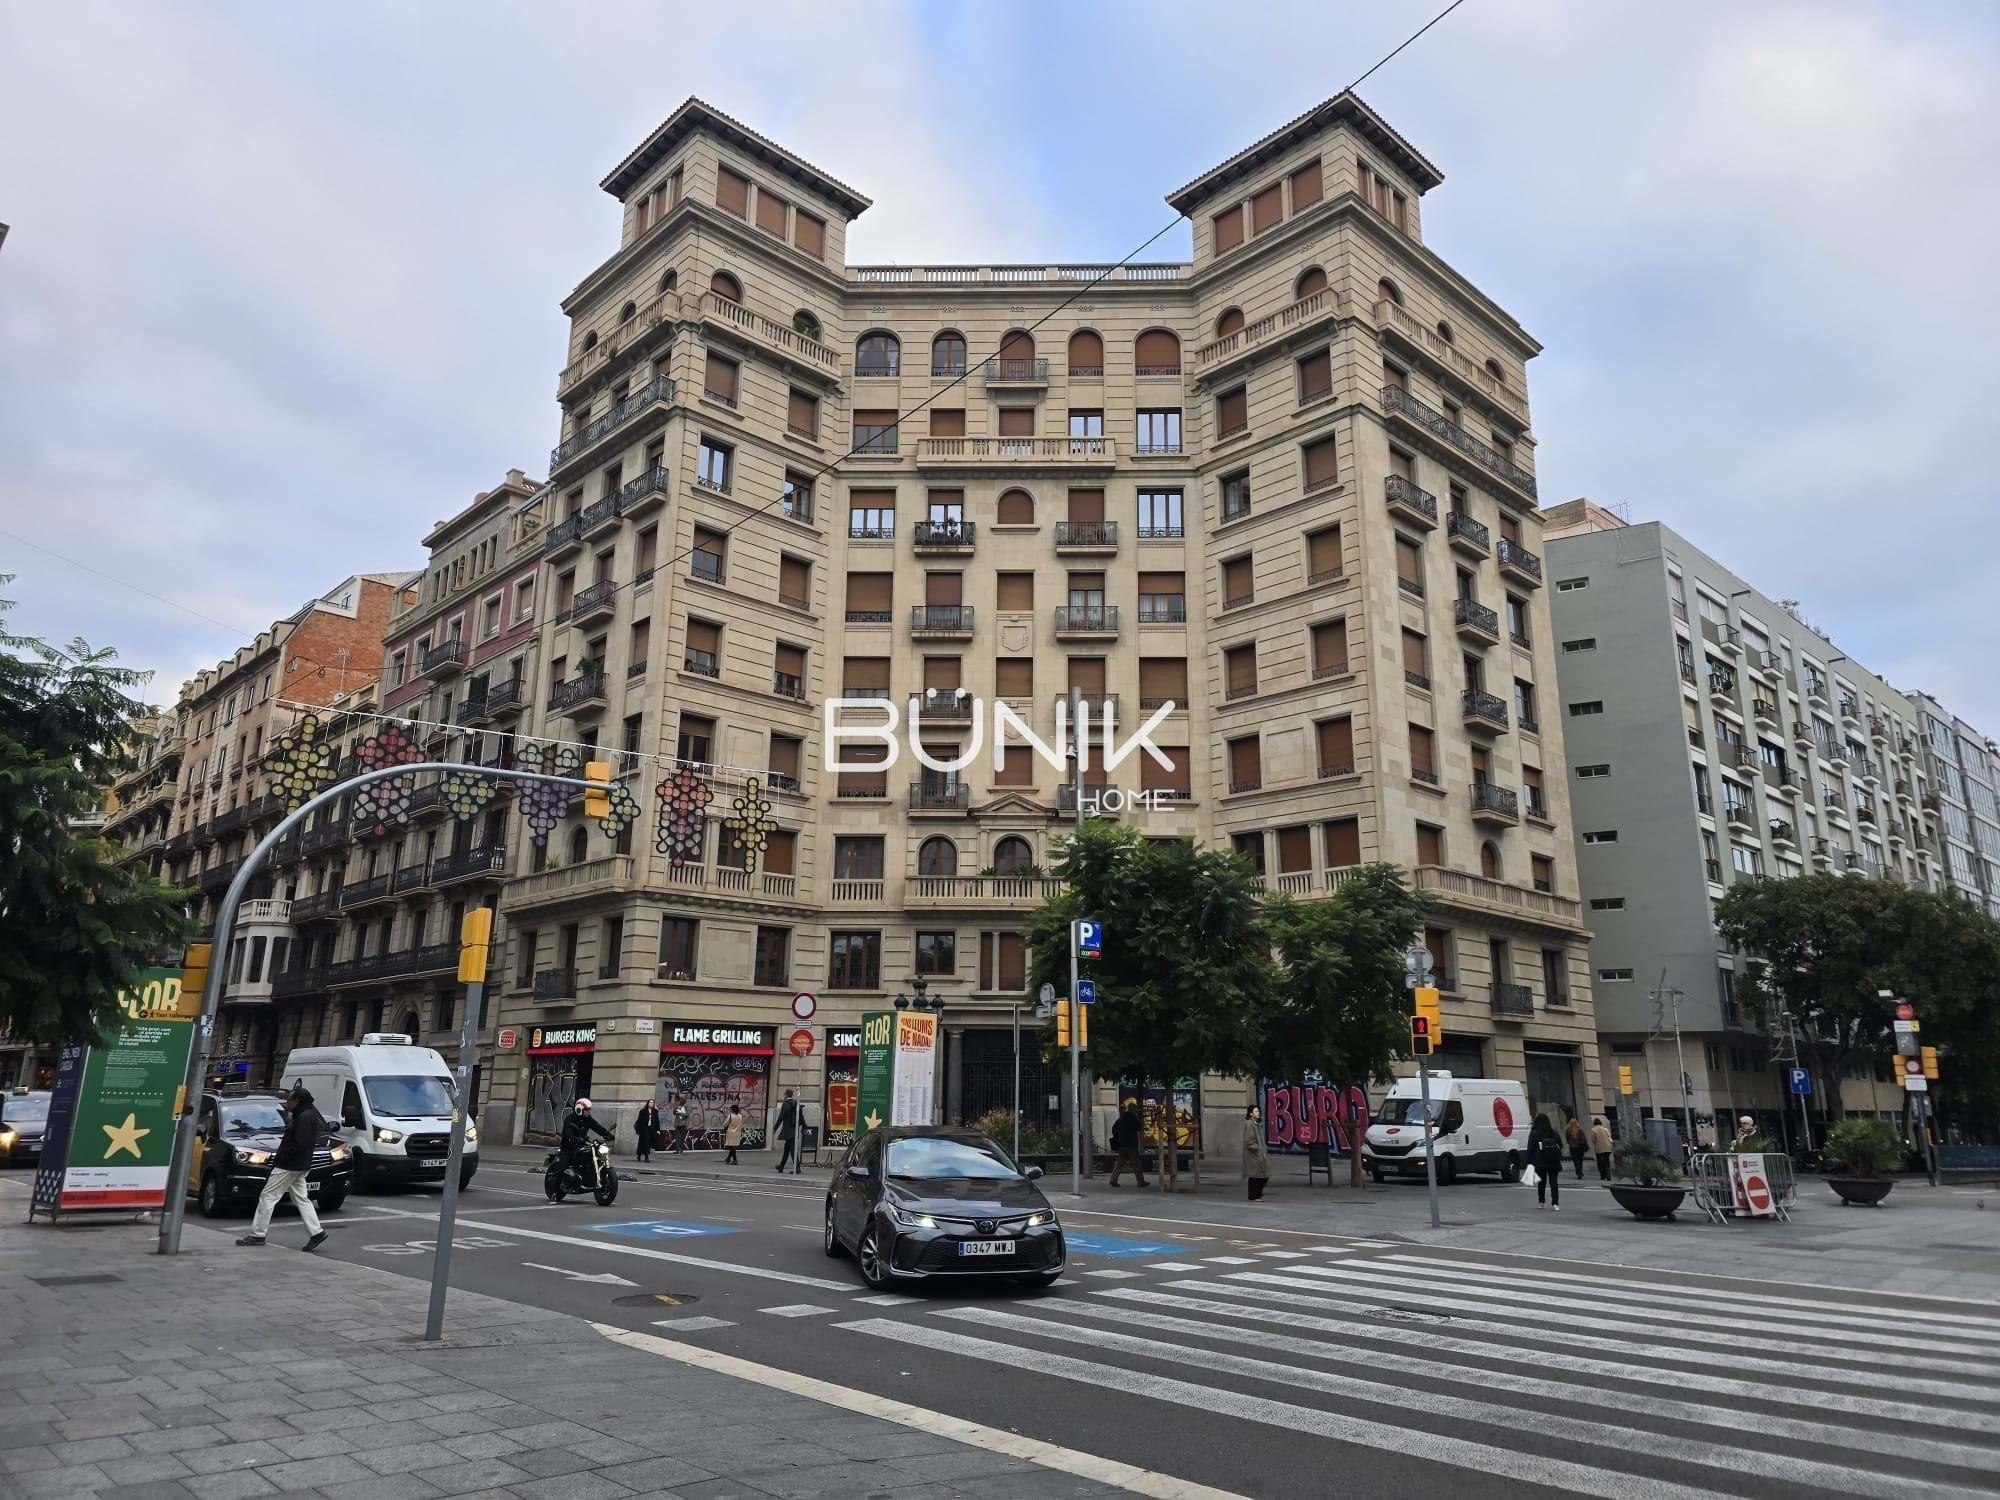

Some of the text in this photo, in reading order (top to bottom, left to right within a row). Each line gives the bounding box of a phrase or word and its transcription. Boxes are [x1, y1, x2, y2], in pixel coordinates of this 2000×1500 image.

[1080, 922, 1093, 945] P
[865, 1014, 890, 1046] FLOR
[912, 1018, 933, 1036] LLUMS
[545, 1028, 596, 1044] BURGER KING
[673, 1028, 761, 1045] FLAME GRILLING
[900, 1028, 911, 1047] DE
[1793, 1070, 1805, 1084] P
[966, 1242, 991, 1254] 0347
